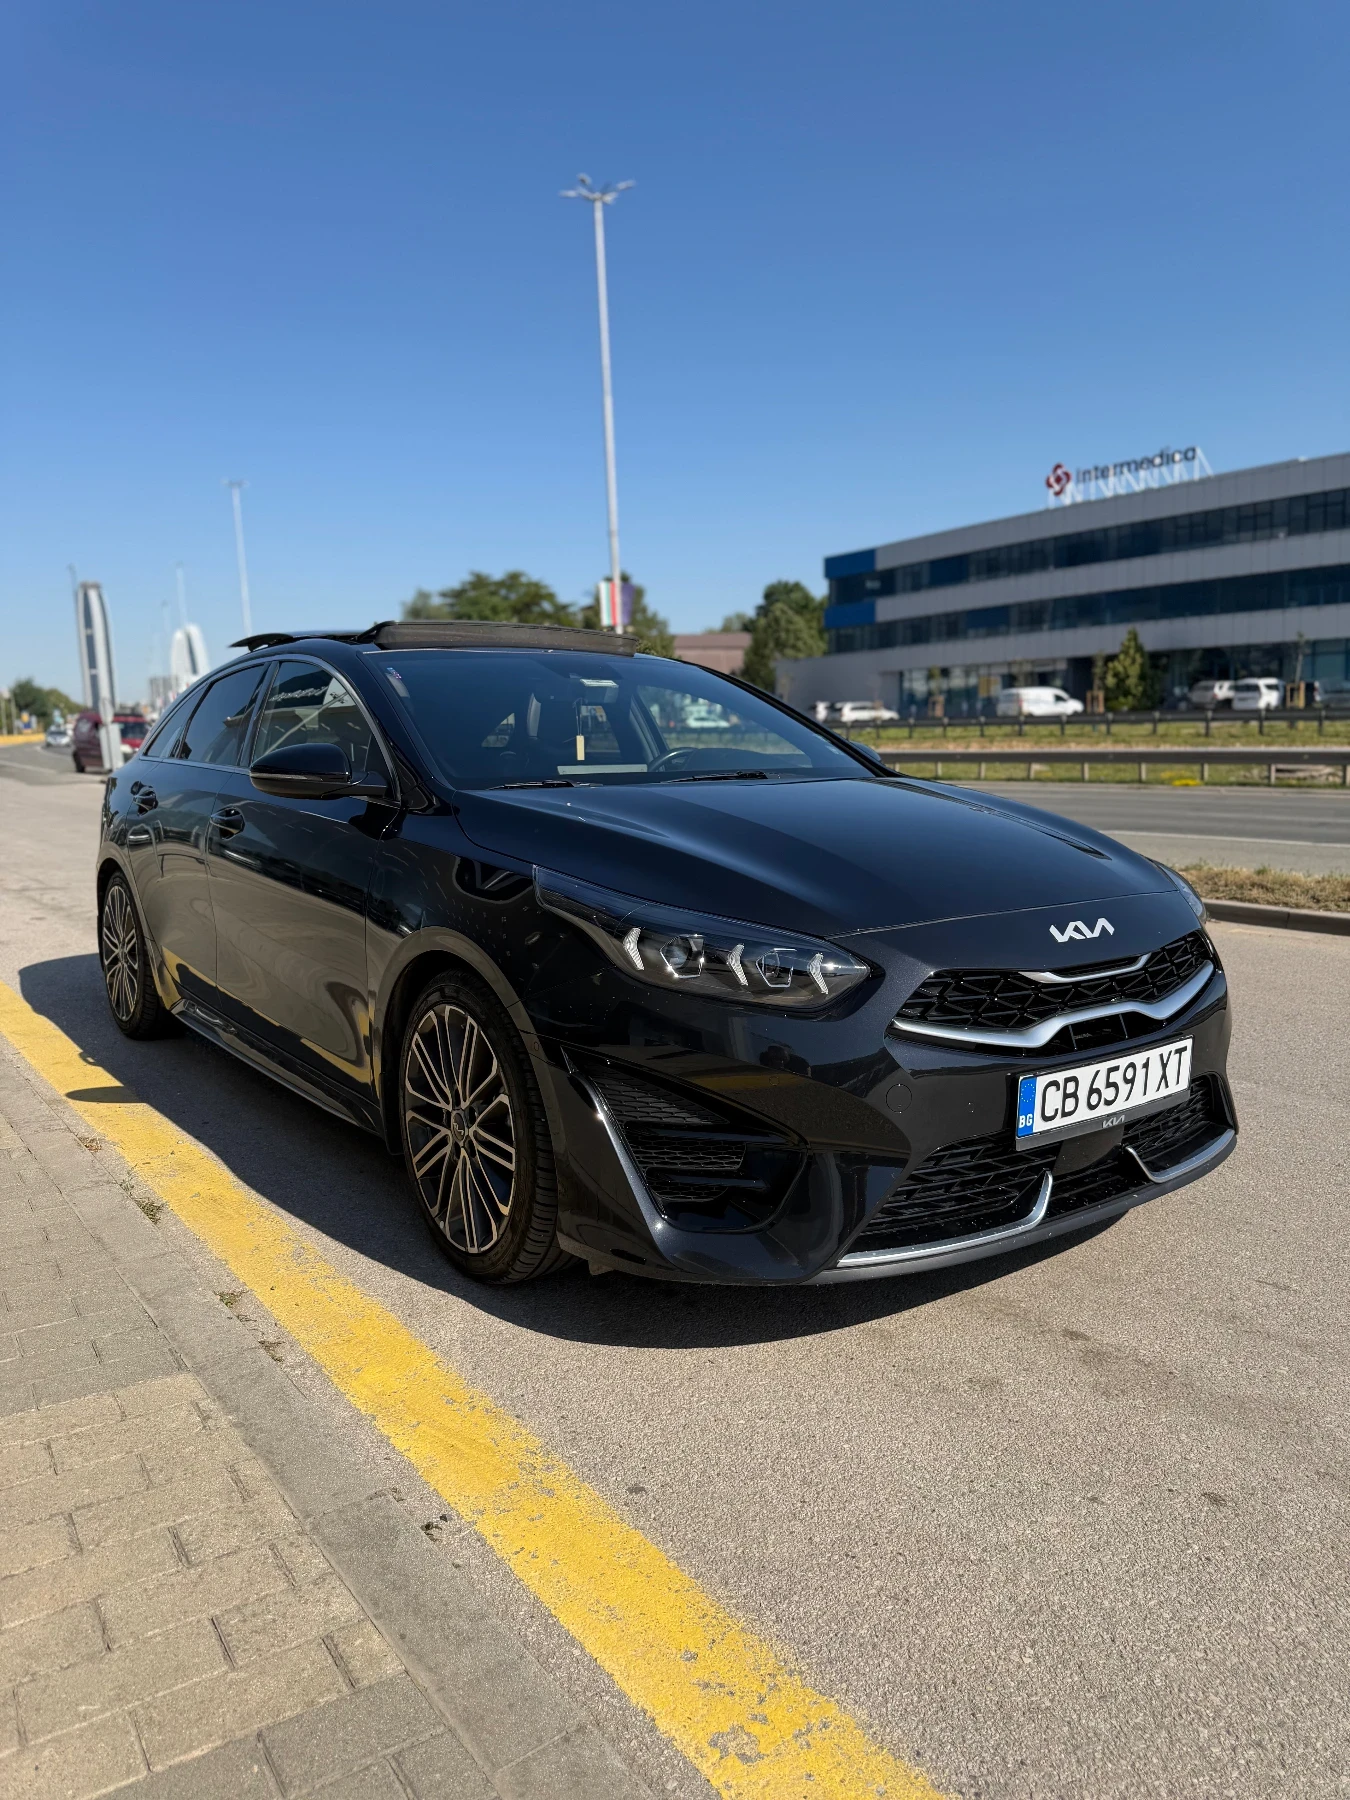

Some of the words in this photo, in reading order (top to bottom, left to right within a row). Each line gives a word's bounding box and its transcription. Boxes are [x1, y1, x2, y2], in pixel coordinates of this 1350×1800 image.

[1077, 445, 1196, 484] intermedica
[1049, 917, 1115, 943] KIA
[1041, 1075, 1080, 1122] CB
[1086, 1057, 1150, 1111] 6591
[1155, 1046, 1188, 1093] XT
[1019, 1114, 1034, 1128] BG
